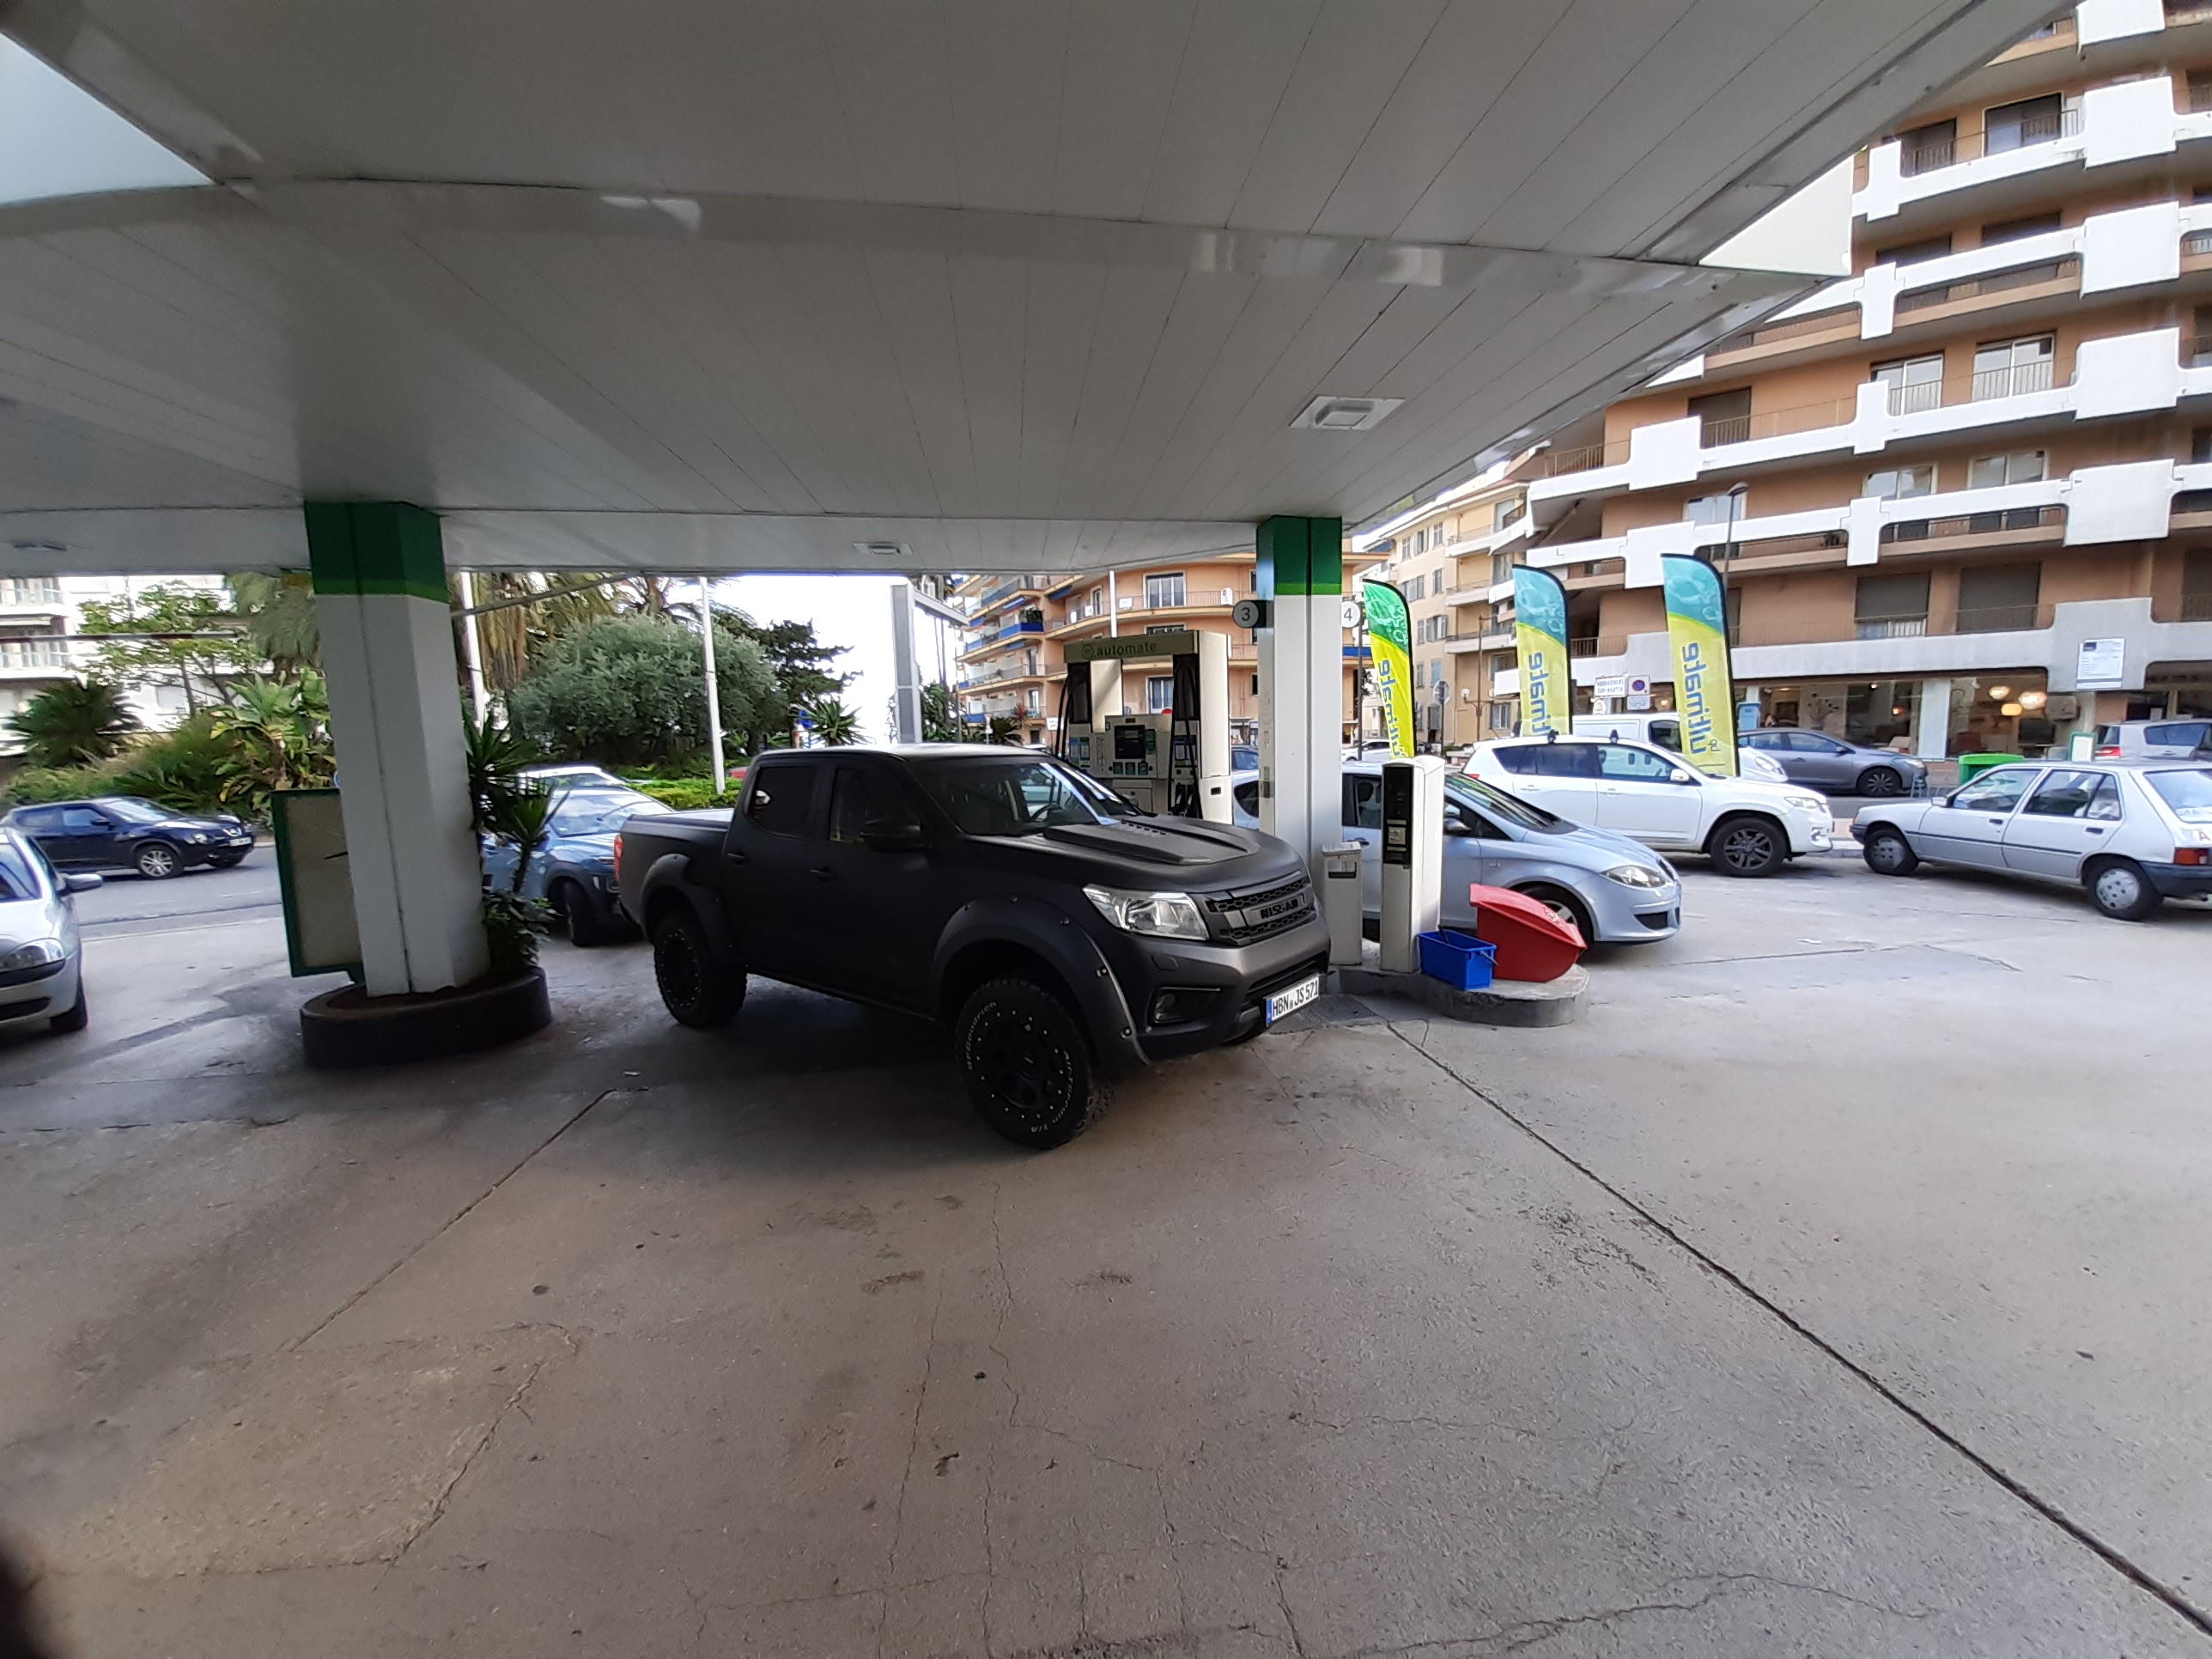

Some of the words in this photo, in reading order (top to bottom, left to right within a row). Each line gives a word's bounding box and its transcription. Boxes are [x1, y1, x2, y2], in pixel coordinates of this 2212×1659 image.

[1241, 606, 1251, 622] 3
[1343, 607, 1353, 622] 4
[1096, 641, 1157, 656] automate
[2197, 830, 2212, 842] A
[1273, 994, 1290, 1017] HBN
[1295, 987, 1304, 1006] JS
[1305, 979, 1318, 1000] 571
